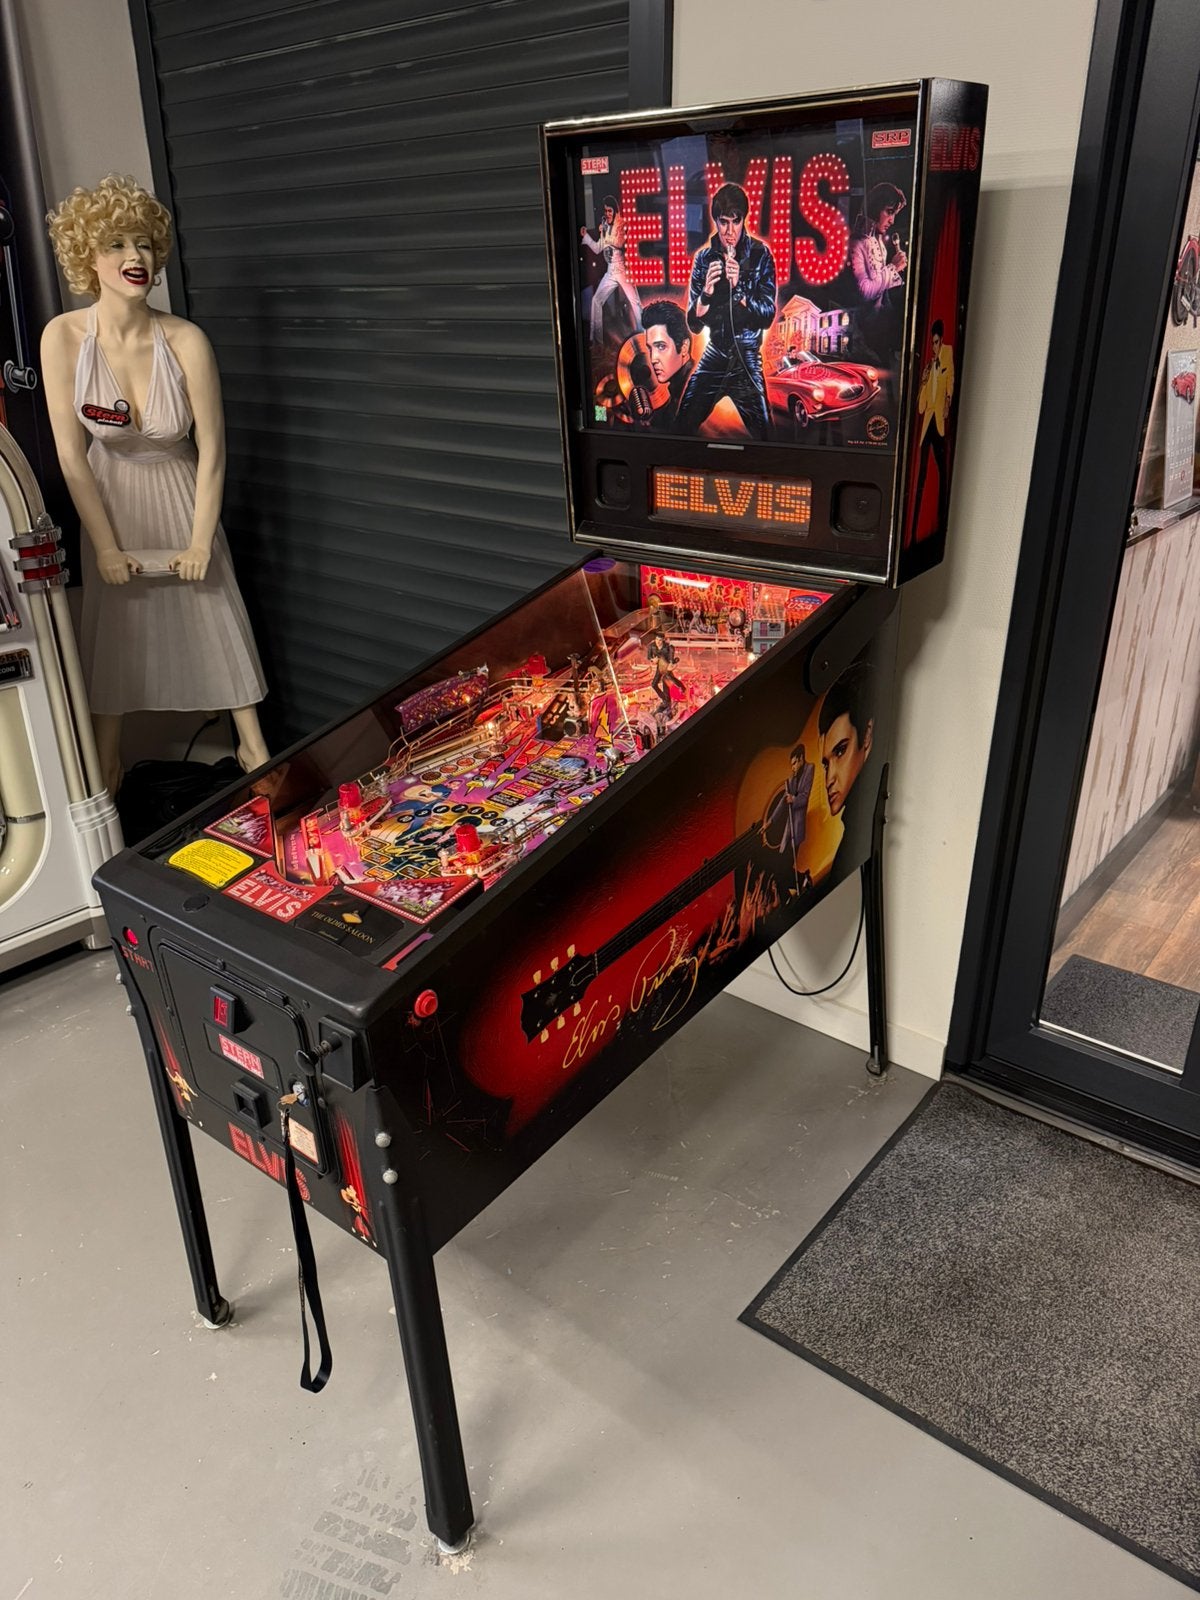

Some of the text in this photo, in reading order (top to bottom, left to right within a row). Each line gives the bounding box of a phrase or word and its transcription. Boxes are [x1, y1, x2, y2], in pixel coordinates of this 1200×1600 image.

[873, 131, 909, 143] SRP
[930, 123, 980, 172] ELVIS
[582, 157, 608, 171] STERN
[619, 152, 851, 288] ELVIS
[656, 472, 812, 524] ELVIS
[227, 878, 301, 918] ELVIS
[311, 911, 325, 921] THE
[325, 915, 348, 932] OLDIES
[345, 926, 375, 945] SALOON
[121, 945, 155, 972] START
[221, 1040, 262, 1072] STERN
